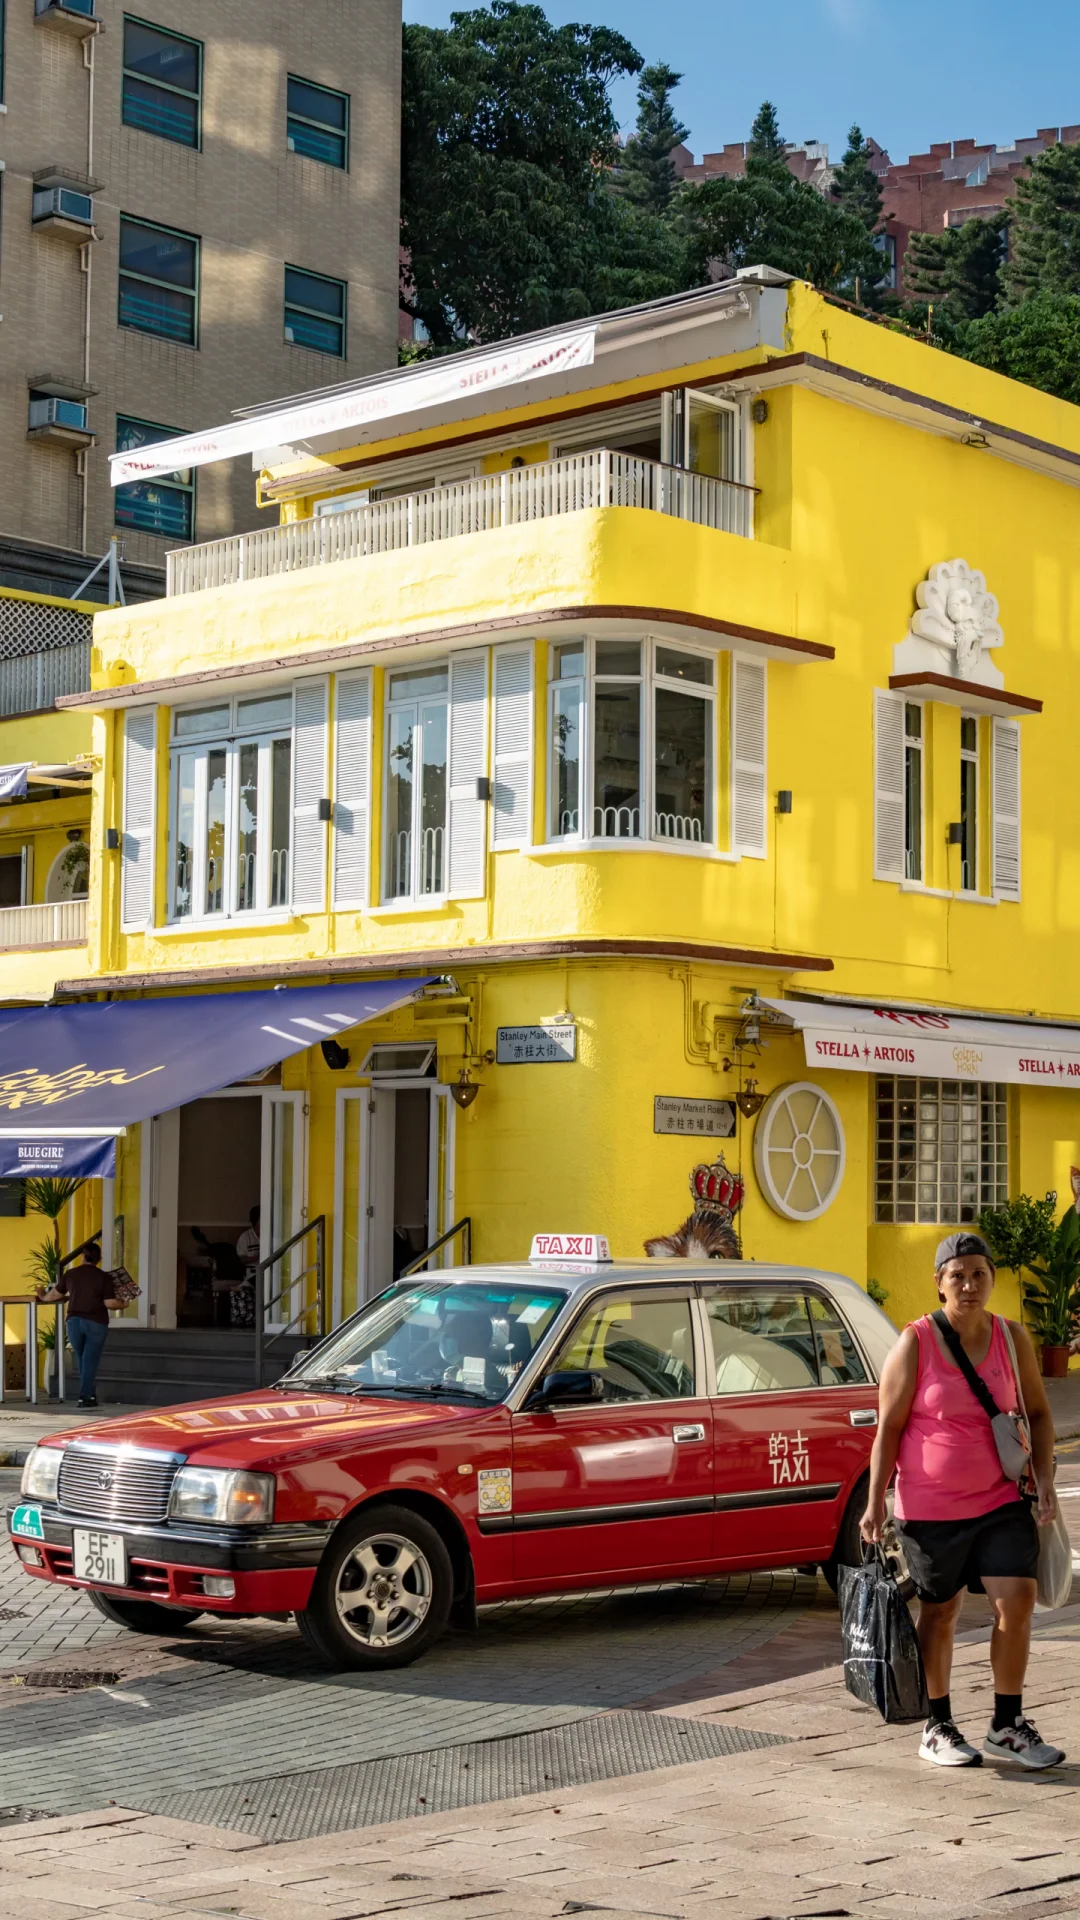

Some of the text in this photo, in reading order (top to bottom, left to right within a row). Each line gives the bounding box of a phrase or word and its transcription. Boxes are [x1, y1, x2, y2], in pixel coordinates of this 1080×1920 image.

[499, 1029, 573, 1042] Stanley Main Street
[513, 1044, 558, 1059] 赤柱大街
[815, 1040, 916, 1063] STELLA ARTOIS
[1018, 1058, 1056, 1075] STELLA
[656, 1101, 725, 1115] Stanley Market Road
[666, 1116, 715, 1132] 赤柱市場道
[18, 1147, 40, 1158] BLUE
[536, 1236, 593, 1256] TAXI
[768, 1429, 809, 1458] 的士
[768, 1455, 810, 1485] TAXI
[22, 1510, 31, 1525] 4
[17, 1524, 37, 1535] SEATS
[88, 1532, 109, 1557] EF
[85, 1555, 115, 1581] 2911
